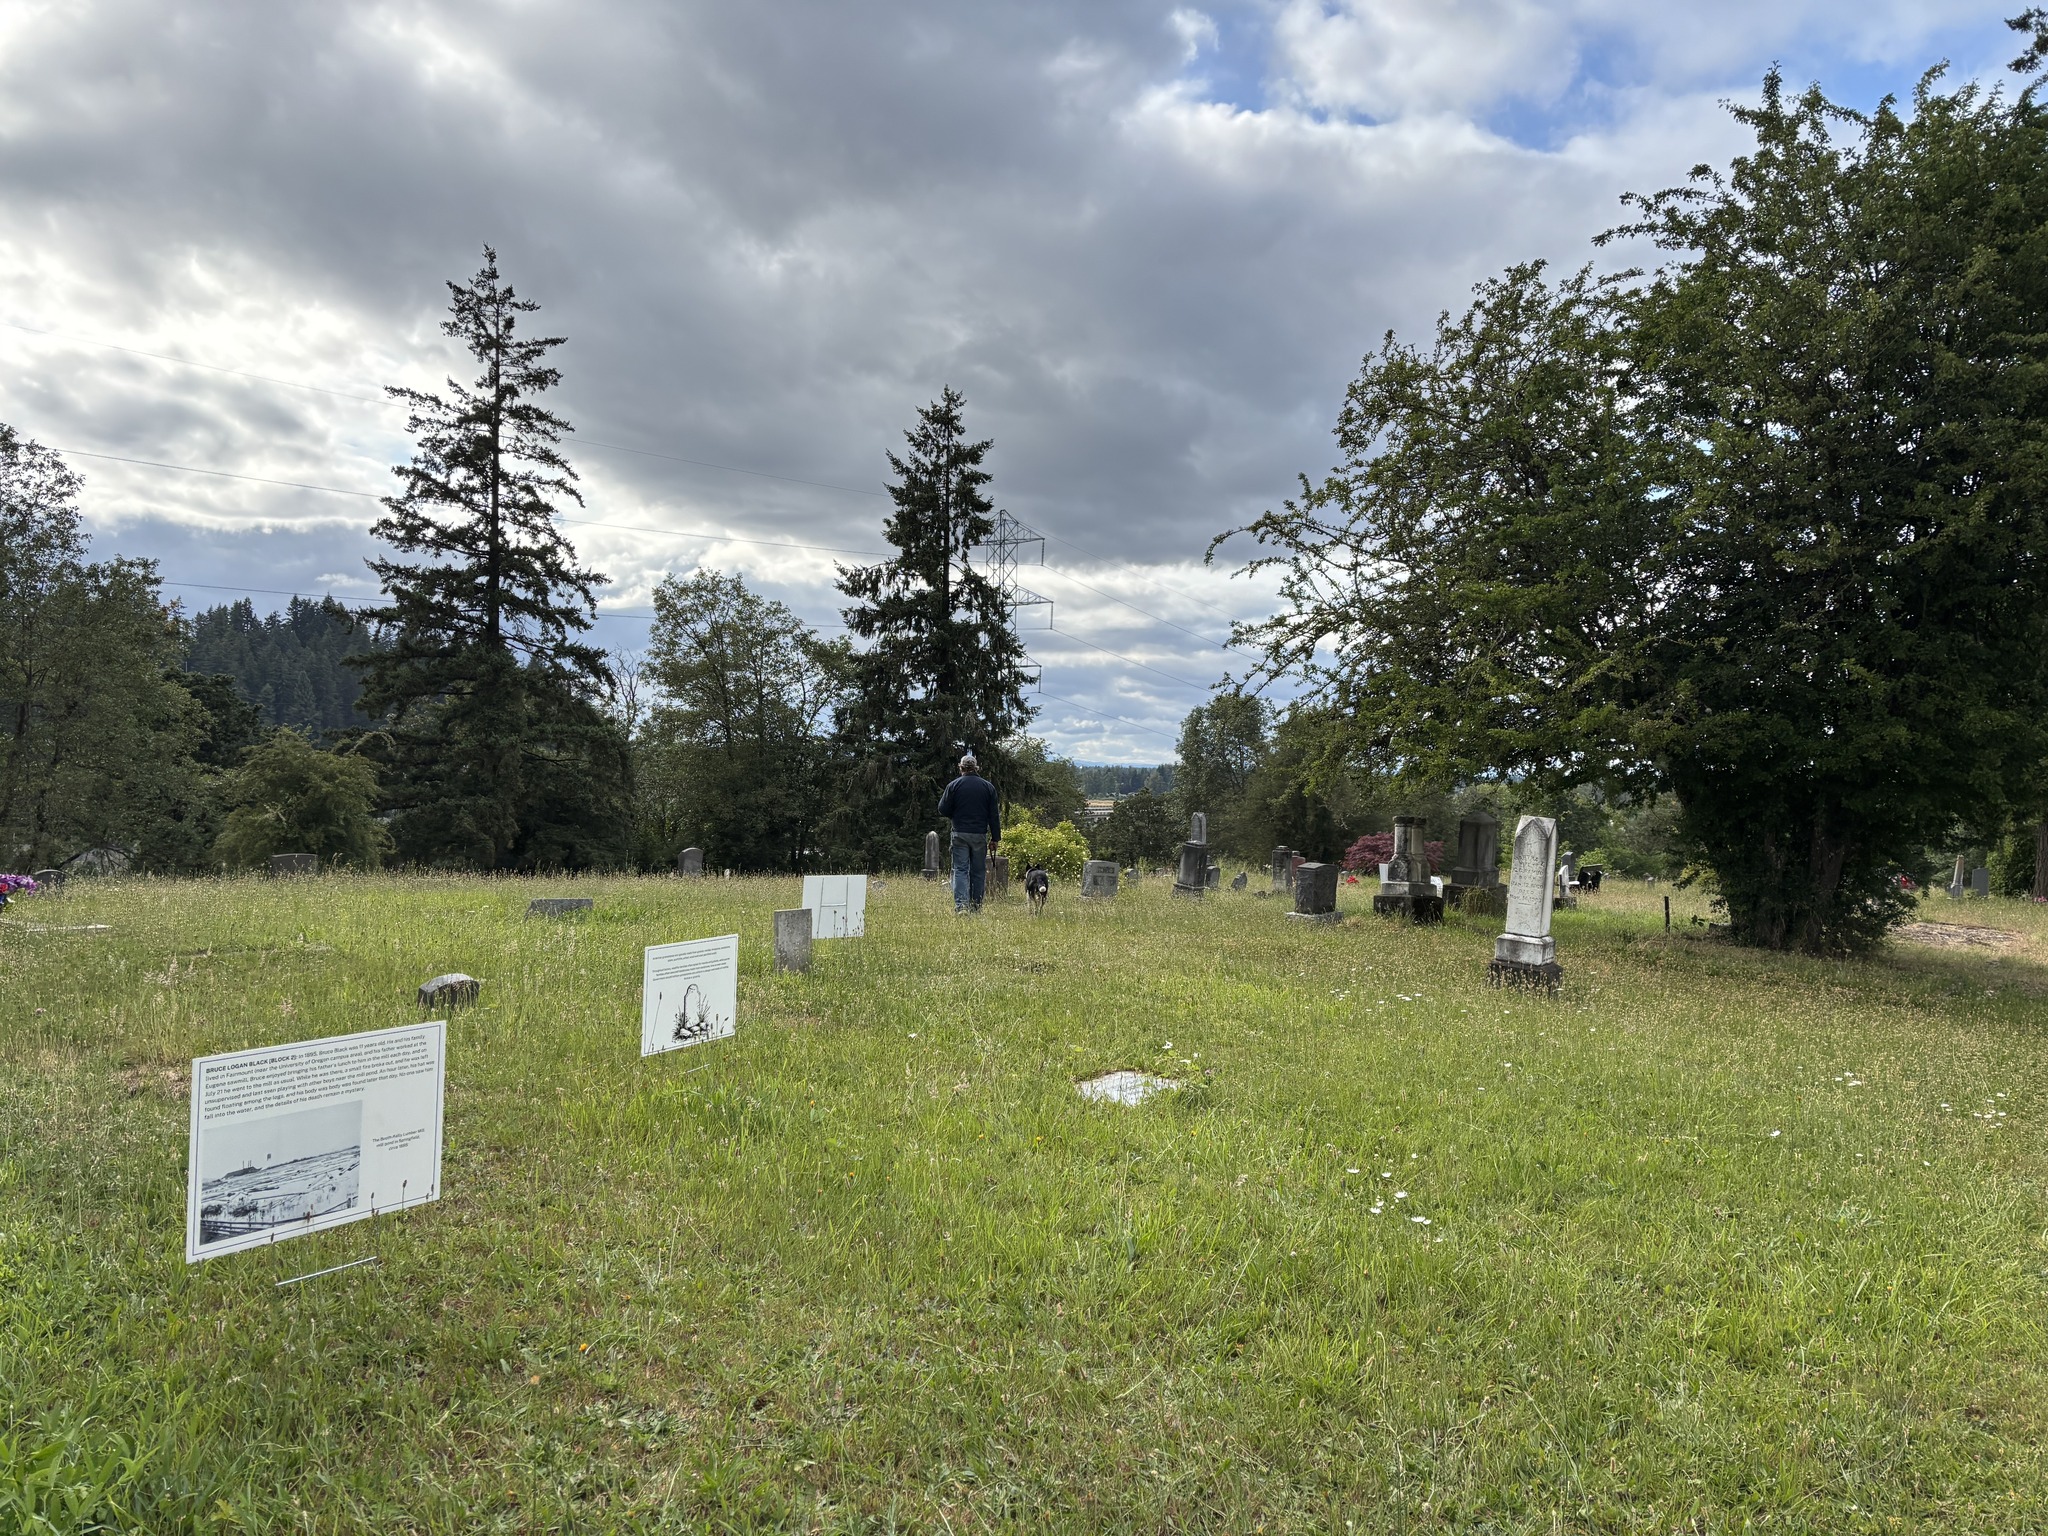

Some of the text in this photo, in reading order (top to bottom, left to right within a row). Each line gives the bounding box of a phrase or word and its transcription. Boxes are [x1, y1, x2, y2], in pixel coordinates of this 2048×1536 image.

[206, 1065, 226, 1074] BRUCE
[227, 1062, 248, 1070] LOGAN
[226, 1069, 254, 1078] Fairmount
[278, 1062, 304, 1070] University
[266, 1071, 287, 1079] enjoyed
